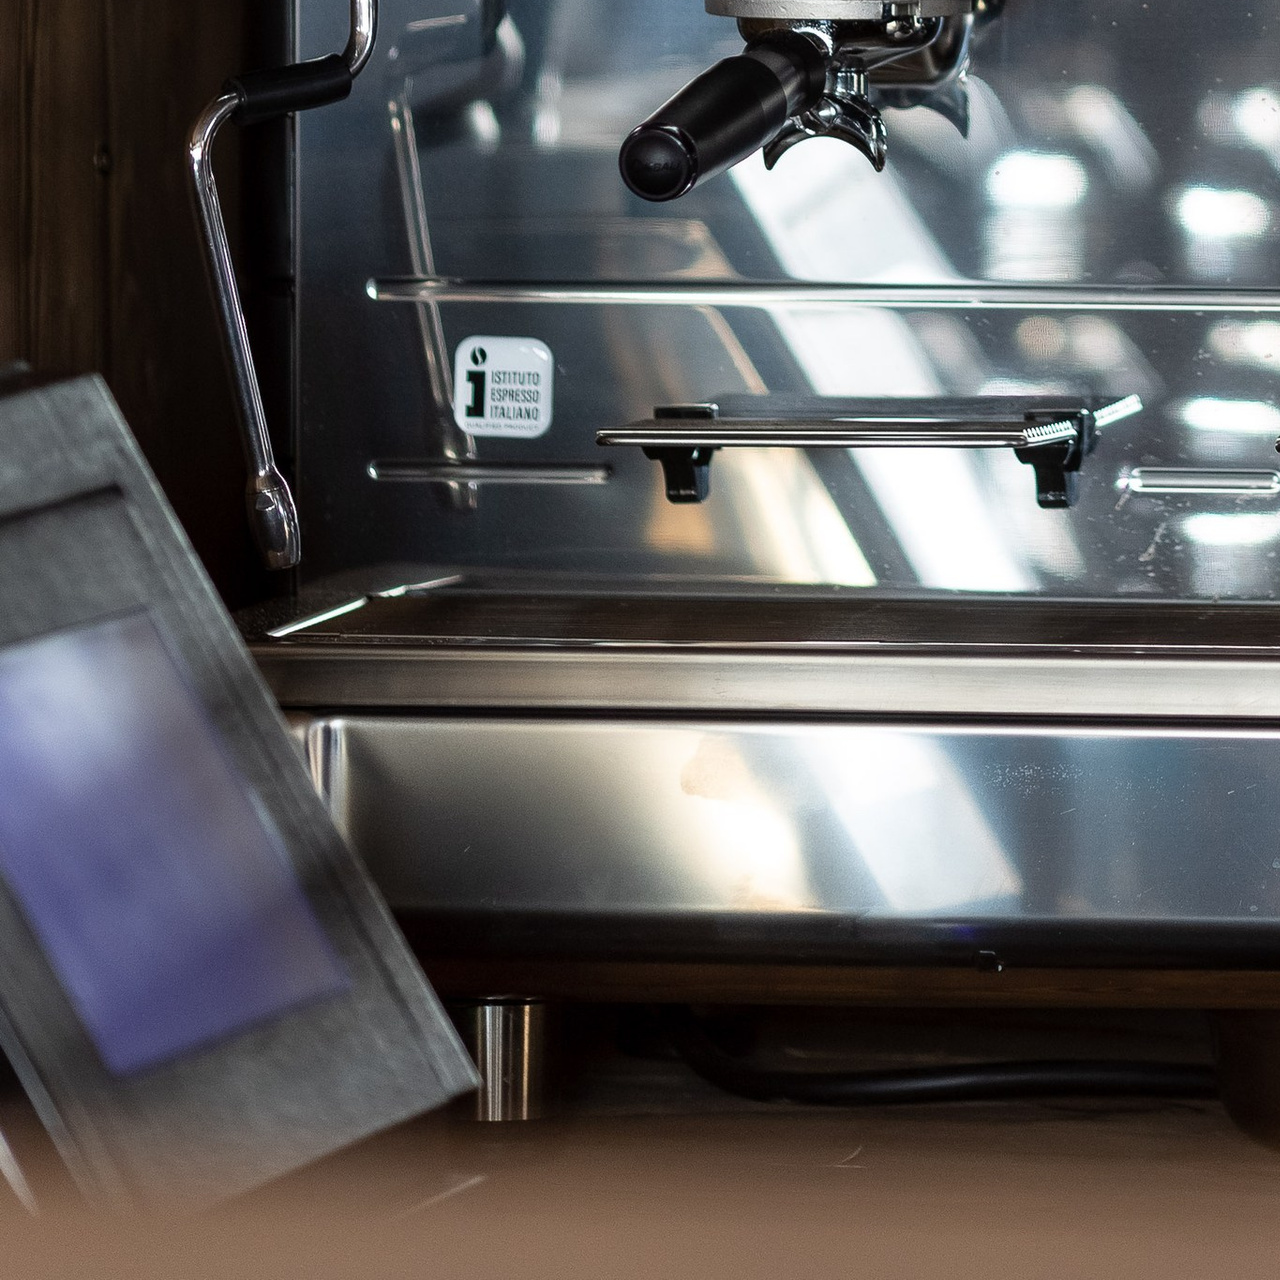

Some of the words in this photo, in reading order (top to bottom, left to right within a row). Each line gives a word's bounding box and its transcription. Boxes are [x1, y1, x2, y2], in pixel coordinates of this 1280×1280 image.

[491, 370, 540, 387] ISTITUTO
[490, 387, 540, 404] ESPRESSO
[489, 404, 540, 421] ITALIANO
